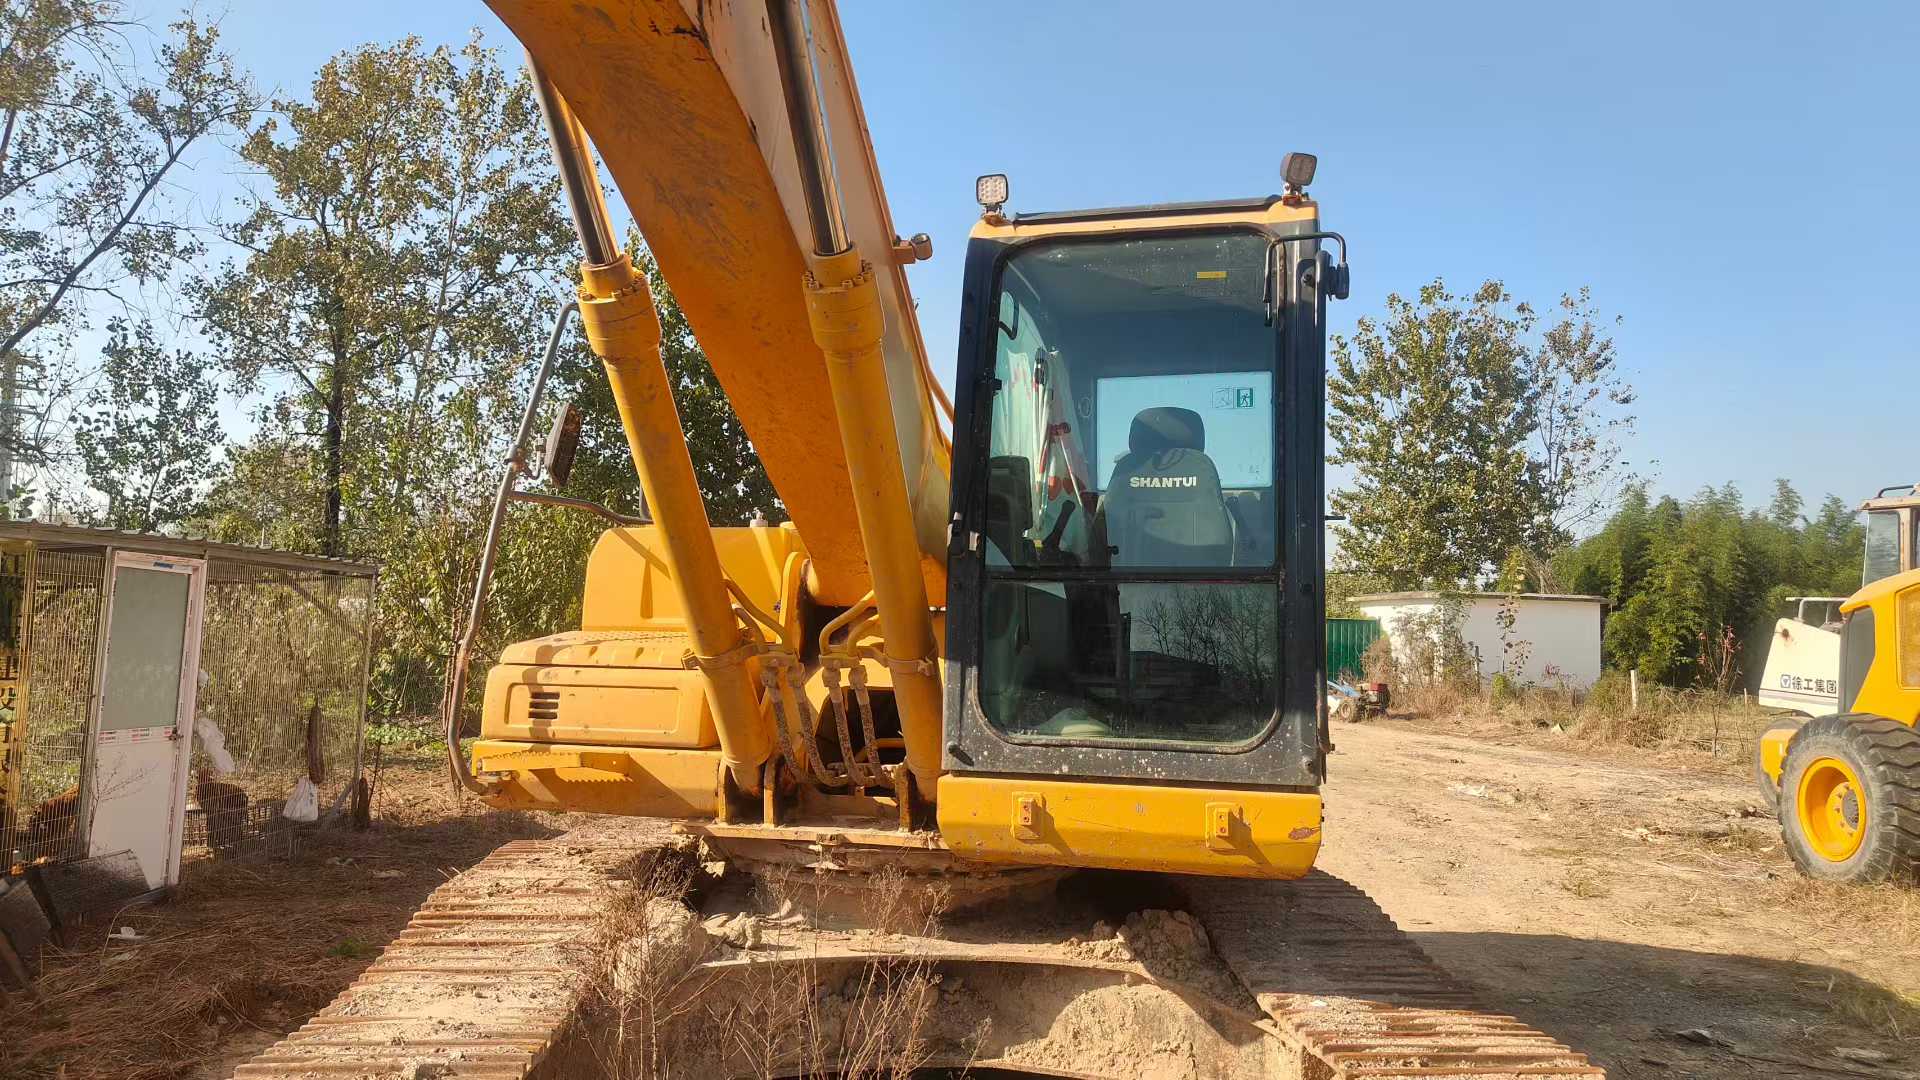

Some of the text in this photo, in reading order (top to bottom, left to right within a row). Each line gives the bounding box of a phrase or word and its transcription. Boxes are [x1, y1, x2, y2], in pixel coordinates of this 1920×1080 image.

[1129, 475, 1197, 488] SHANTUI
[1791, 675, 1837, 694] 徐工集团
